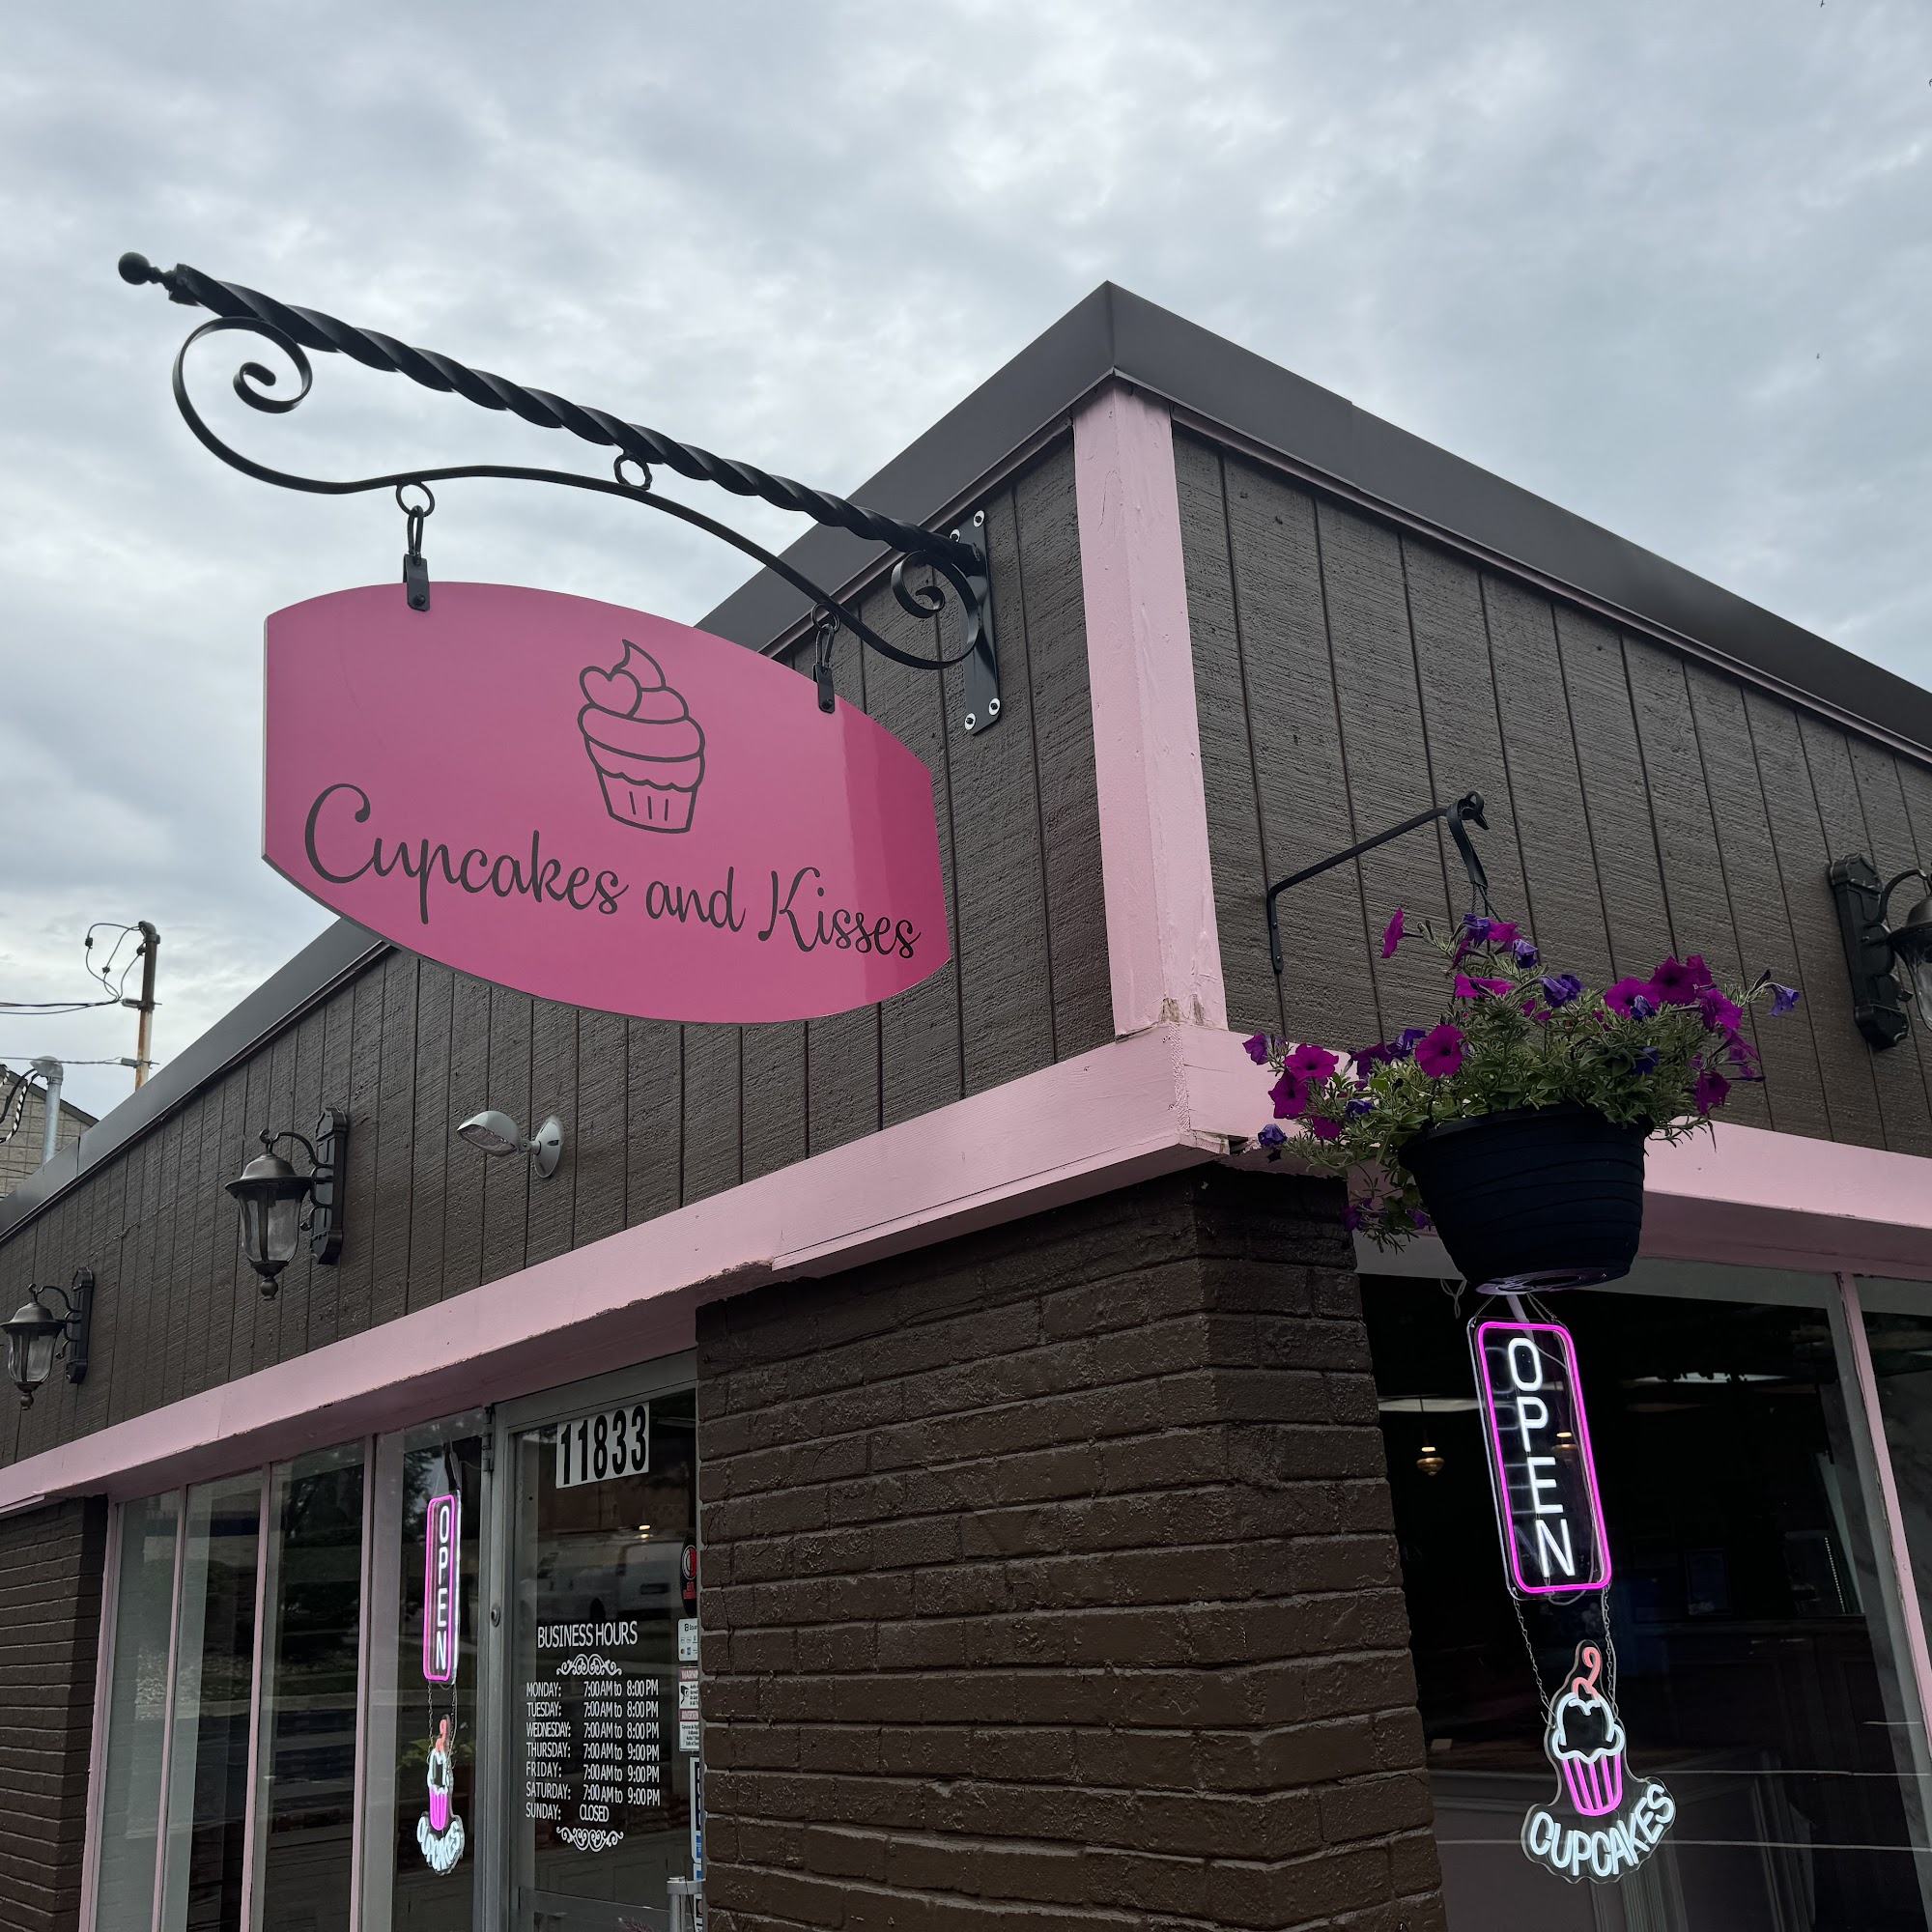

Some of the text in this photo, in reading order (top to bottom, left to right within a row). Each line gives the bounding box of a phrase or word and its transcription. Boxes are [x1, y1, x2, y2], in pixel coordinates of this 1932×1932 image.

[304, 783, 921, 959] Cupcakes and Kisses
[560, 1405, 647, 1485] 11833
[1507, 1337, 1576, 1578] OPEN
[436, 1505, 450, 1670] OPEN
[537, 1620, 639, 1648] BUSINESS HOURS
[526, 1679, 659, 1697] MONDAY: 7:00 AM to 8:00 PM
[526, 1701, 659, 1718] TUESDAY: 7:00 AM to 8:00 PM
[526, 1721, 659, 1739] WEDNESDAY: 7:00 AM to 8:00 PM
[526, 1742, 660, 1761] THURSDAY: 7:00 AM to 9:00 PM
[526, 1761, 660, 1782] FRIDAY: 7:00 AM to 9:00 PM
[526, 1781, 661, 1806] SATURDAY: 7:00 AM to 9:00 PM
[526, 1802, 610, 1822] SUNDAY: CLOSED
[1530, 1783, 1675, 1877] CUPCAKES
